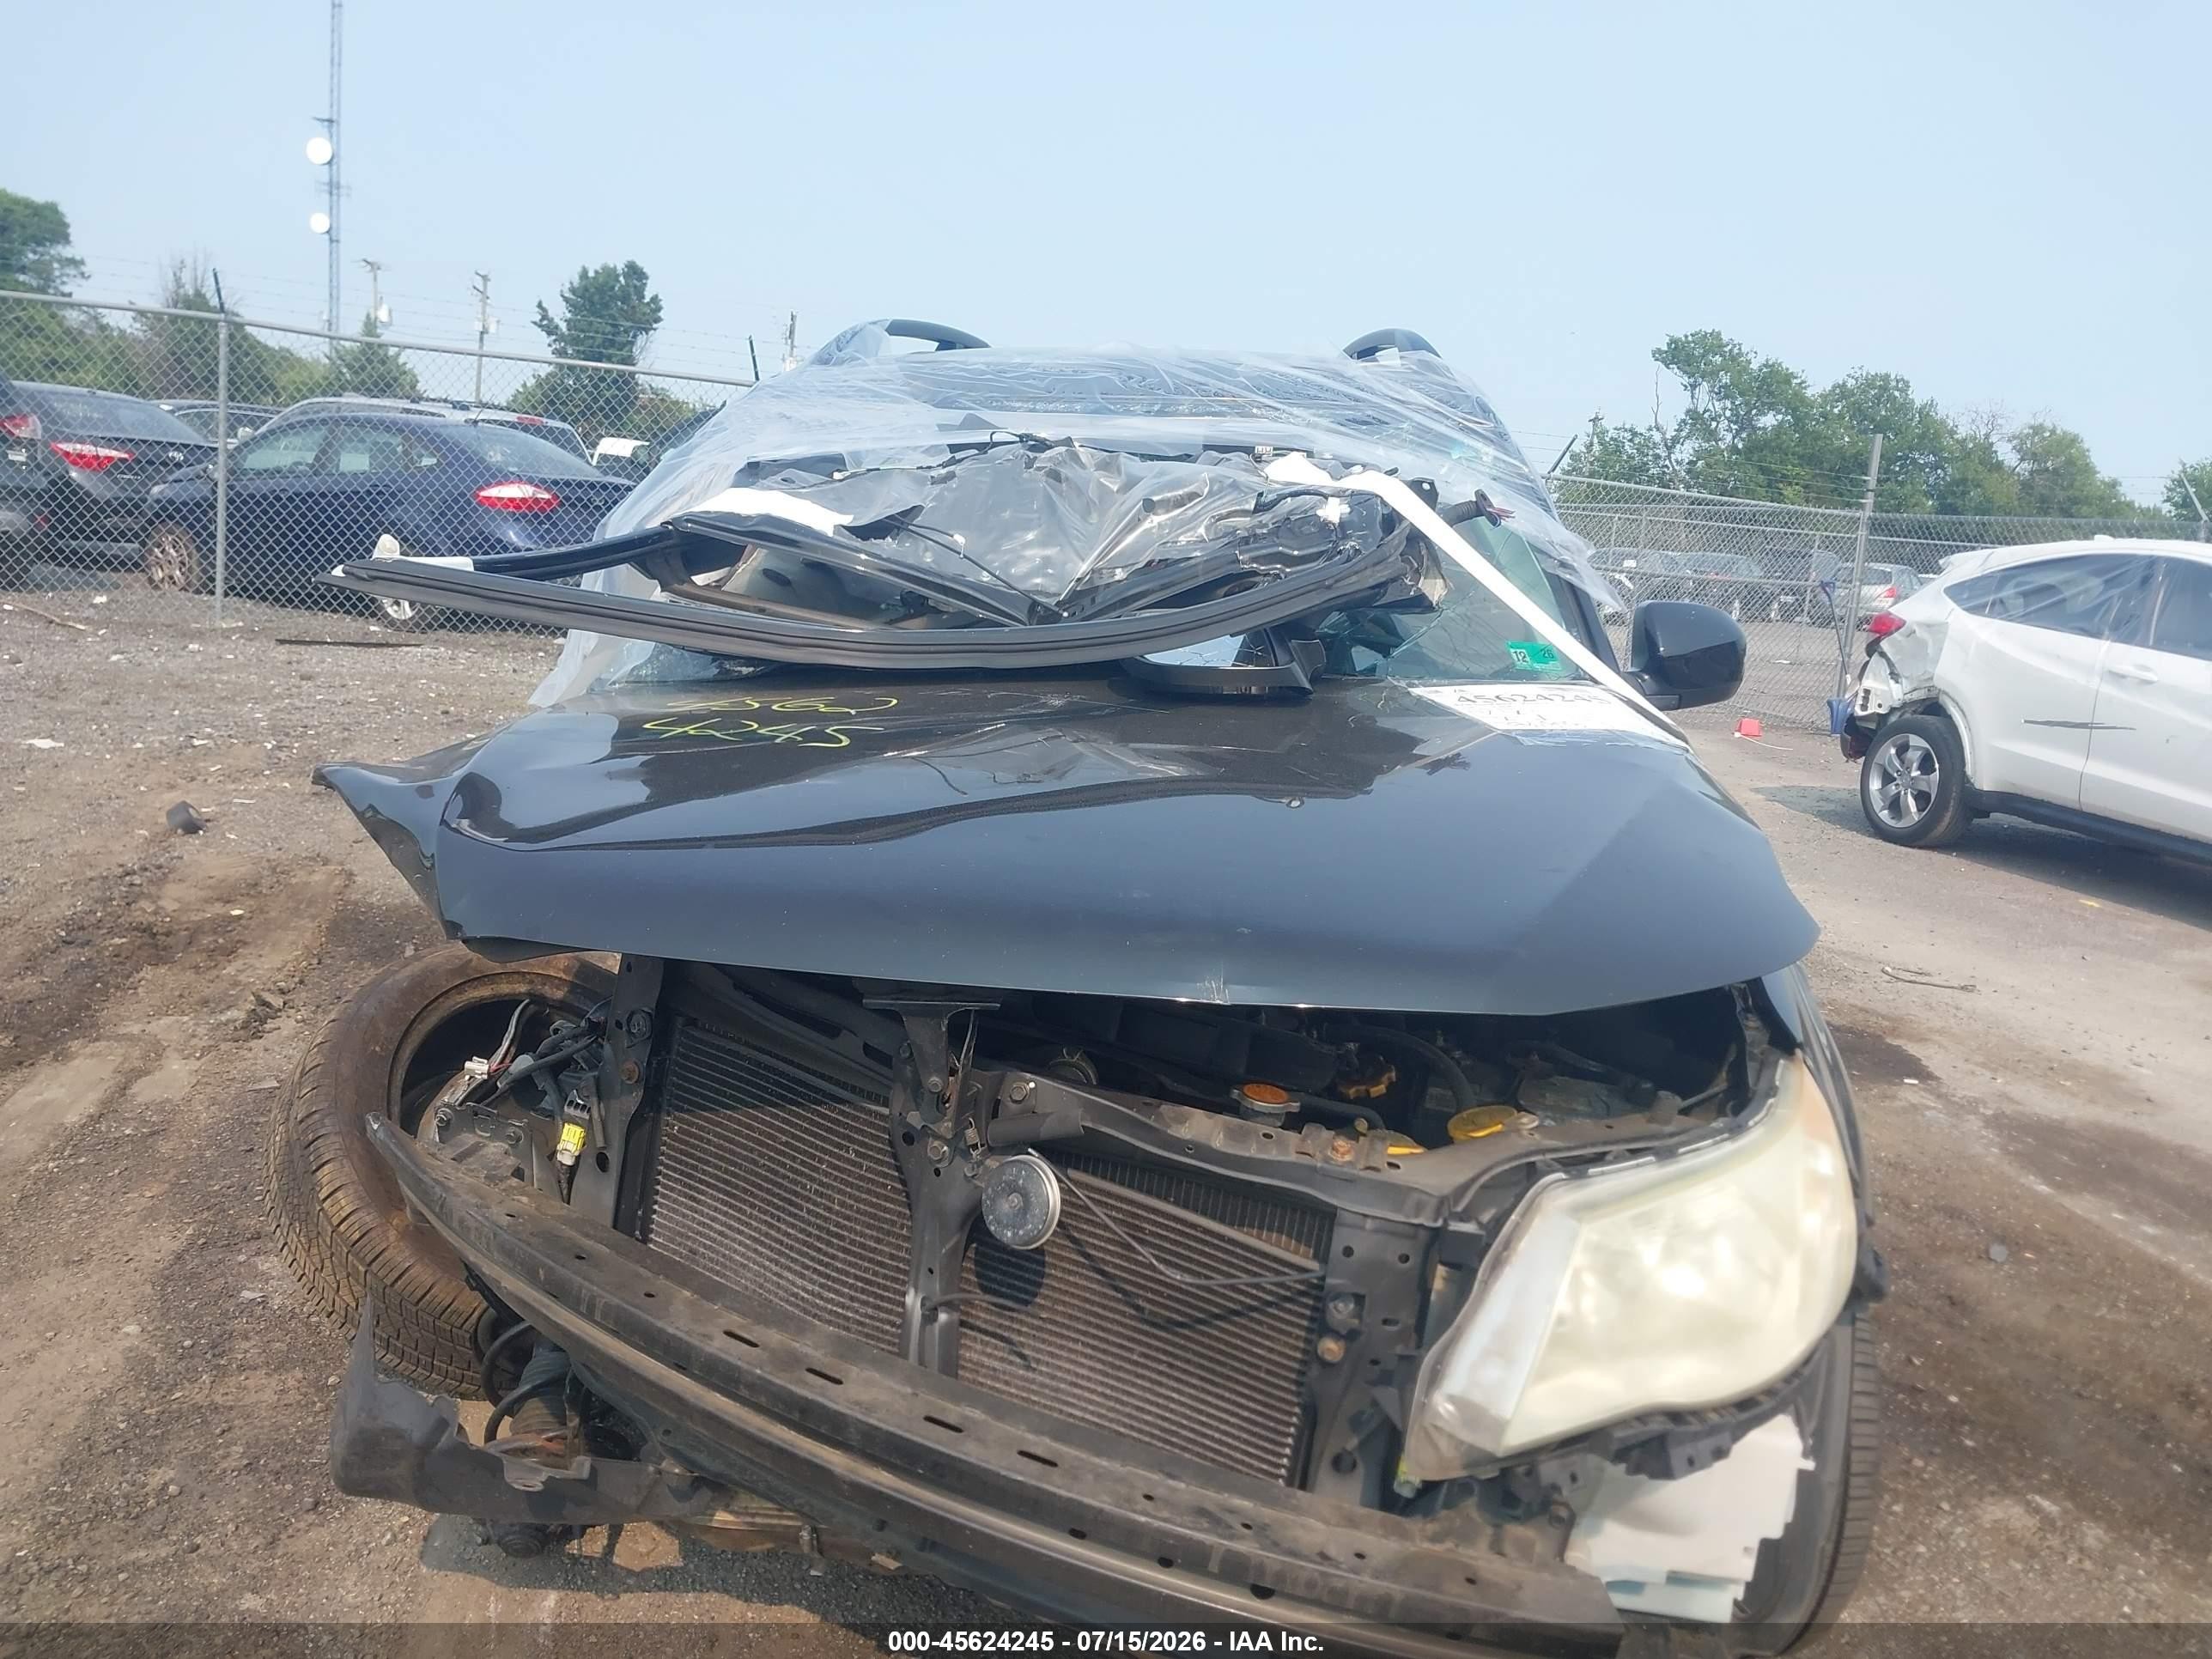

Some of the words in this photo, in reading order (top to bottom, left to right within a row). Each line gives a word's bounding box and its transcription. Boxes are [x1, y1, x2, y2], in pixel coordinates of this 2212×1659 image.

[1512, 650, 1528, 663] 12
[1540, 648, 1554, 659] 26
[642, 718, 884, 747] 4245
